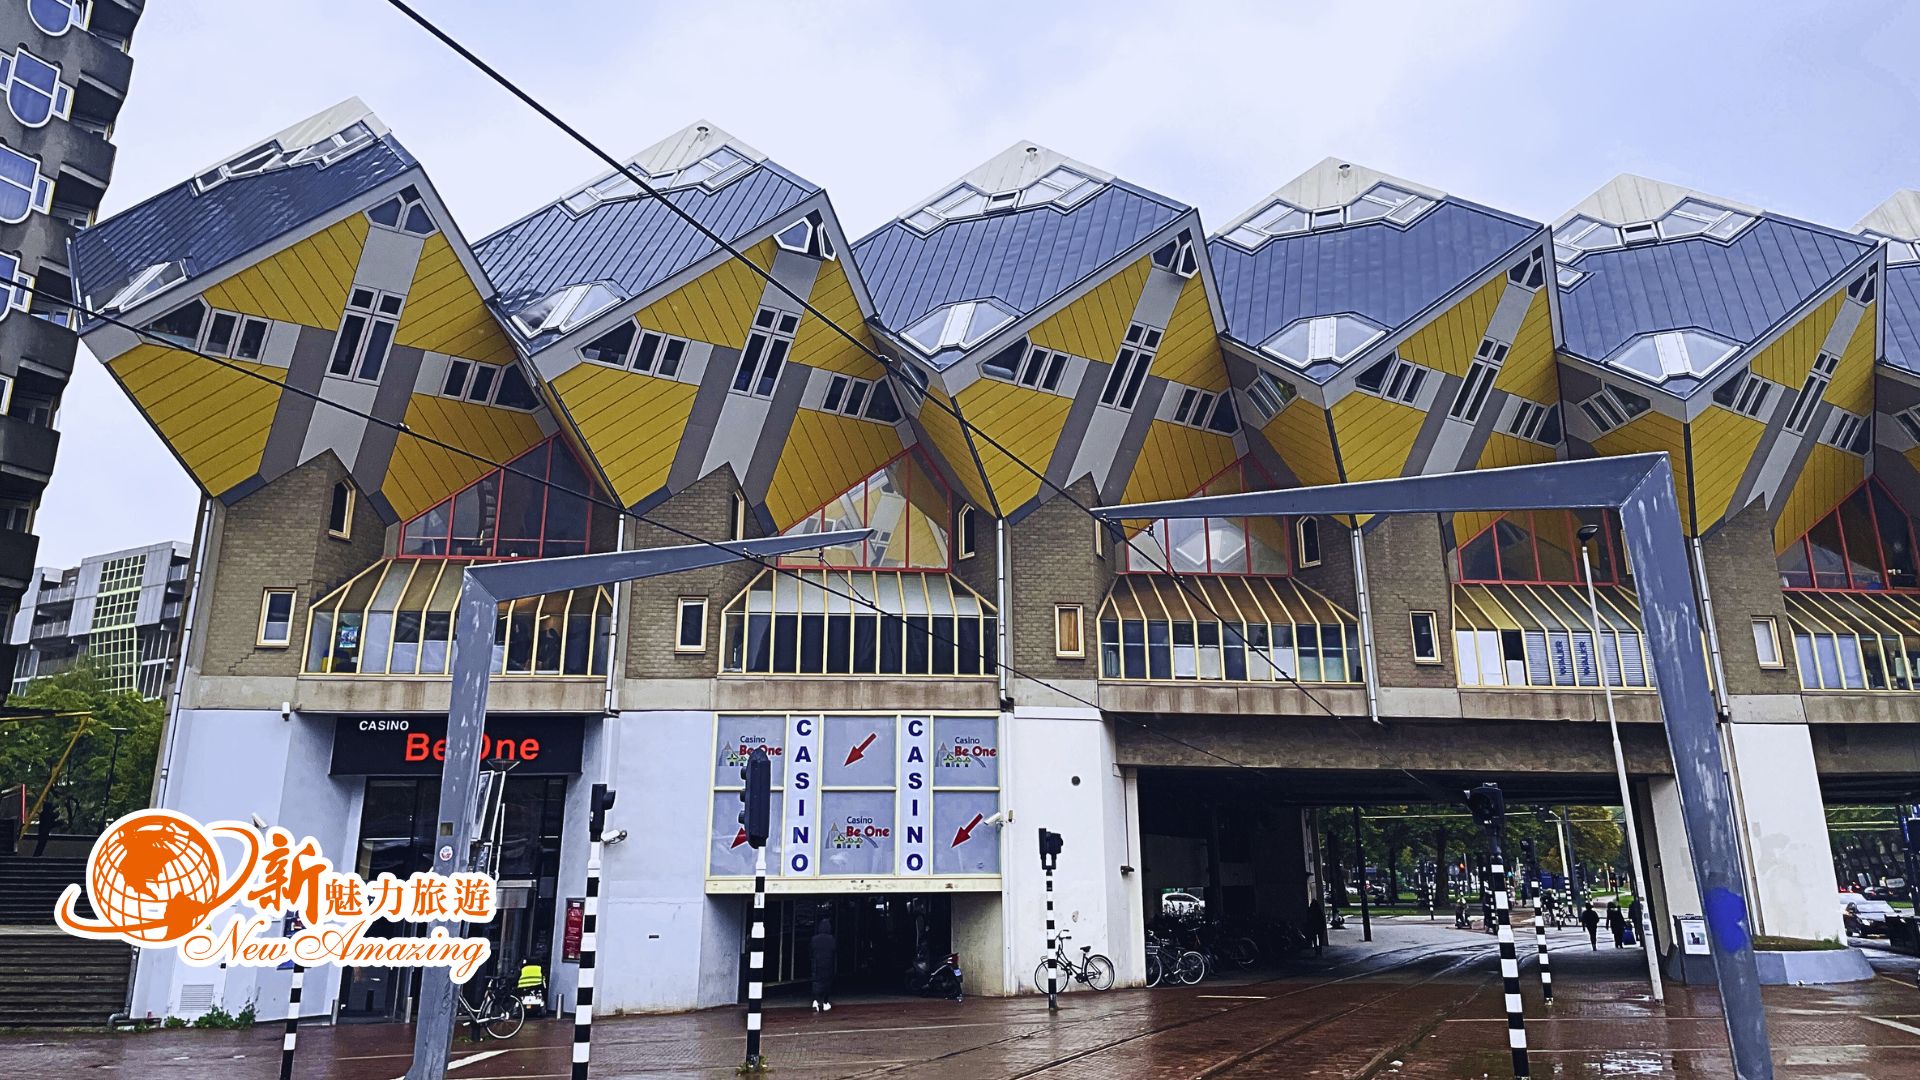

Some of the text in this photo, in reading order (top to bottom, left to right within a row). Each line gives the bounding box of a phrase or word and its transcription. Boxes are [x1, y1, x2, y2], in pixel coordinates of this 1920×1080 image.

[359, 720, 410, 731] CASINO
[740, 735, 766, 744] Casino
[954, 736, 980, 745] Casino
[405, 733, 447, 761] Be
[739, 745, 754, 756] Be
[954, 745, 997, 757] Be One
[791, 719, 812, 873] CASINO
[906, 719, 924, 873] CASINO
[846, 816, 873, 825] Casino
[846, 826, 890, 838] Be One
